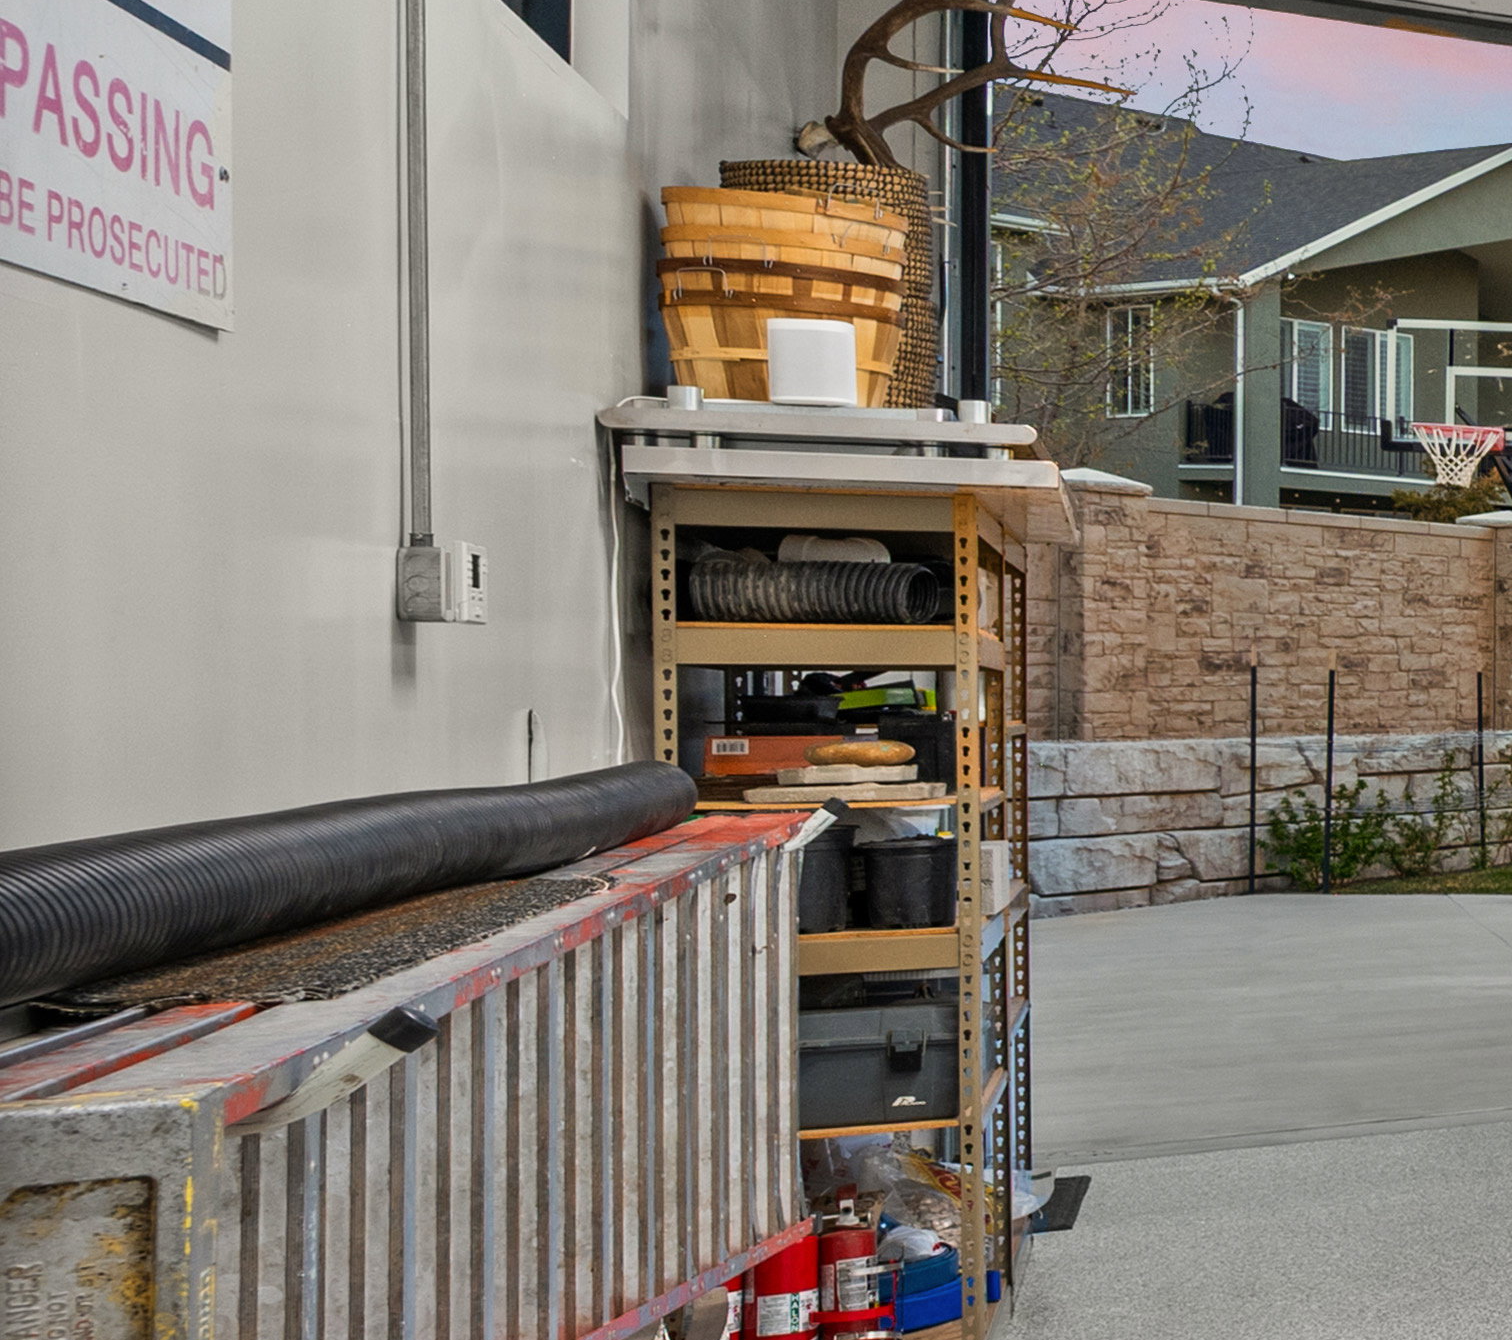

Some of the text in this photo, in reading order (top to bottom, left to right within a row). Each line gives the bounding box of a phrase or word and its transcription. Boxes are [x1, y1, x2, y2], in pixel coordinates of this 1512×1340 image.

[0, 18, 215, 210] PASSING
[0, 170, 227, 300] BE PROSECUTED
